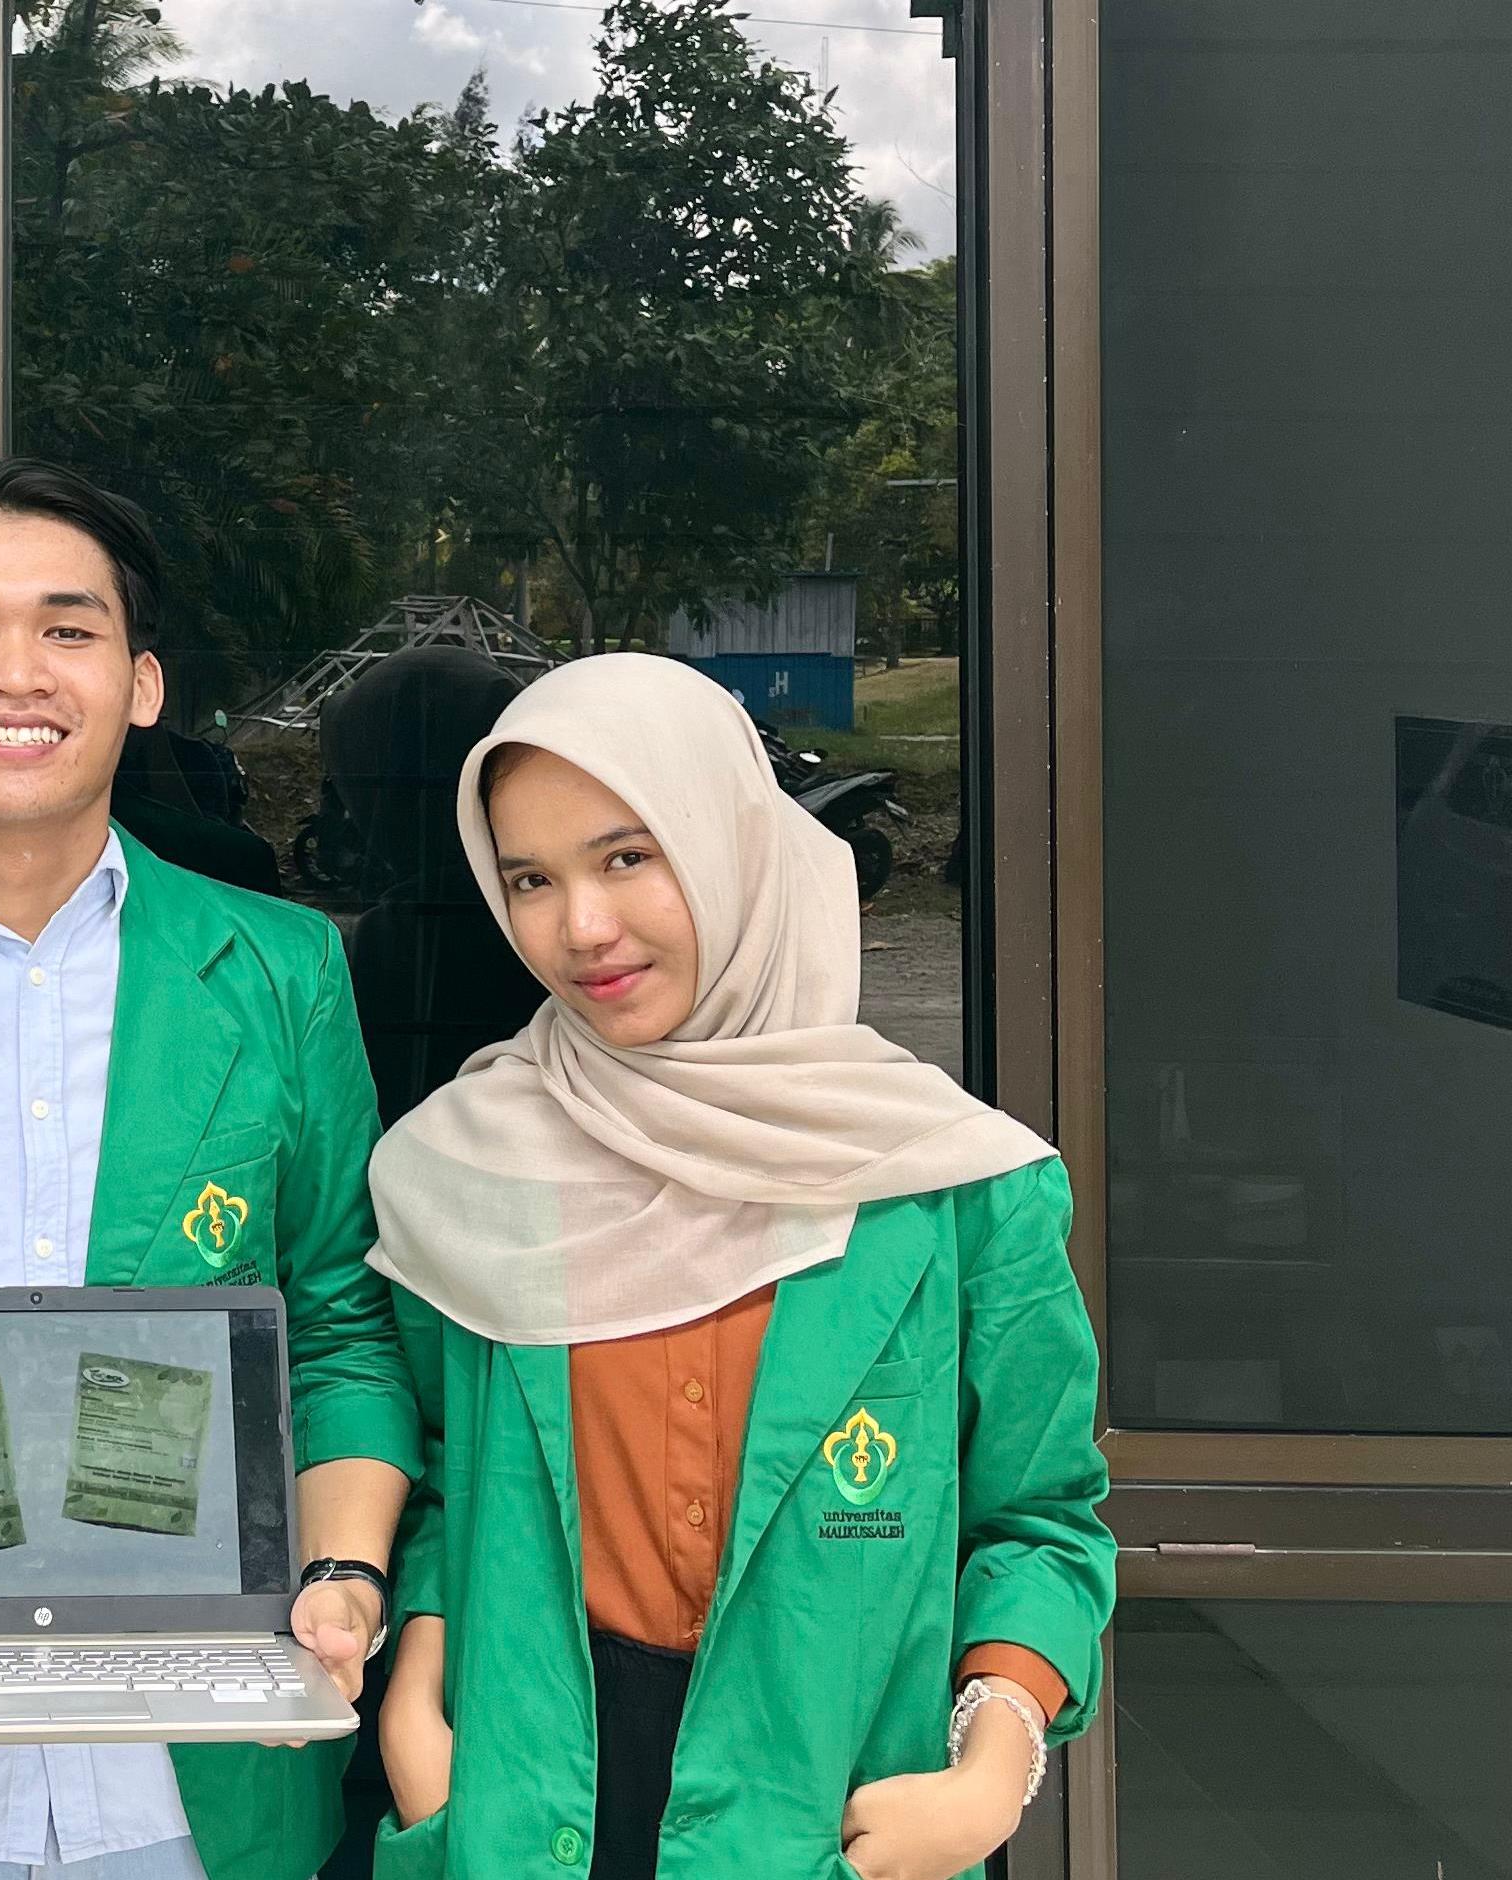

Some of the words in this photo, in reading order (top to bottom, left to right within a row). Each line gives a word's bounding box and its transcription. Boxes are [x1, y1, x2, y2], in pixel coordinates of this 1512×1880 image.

[823, 1509, 902, 1523] universitas
[818, 1524, 905, 1539] MALIKUSSALEH
[35, 1607, 52, 1625] hp
